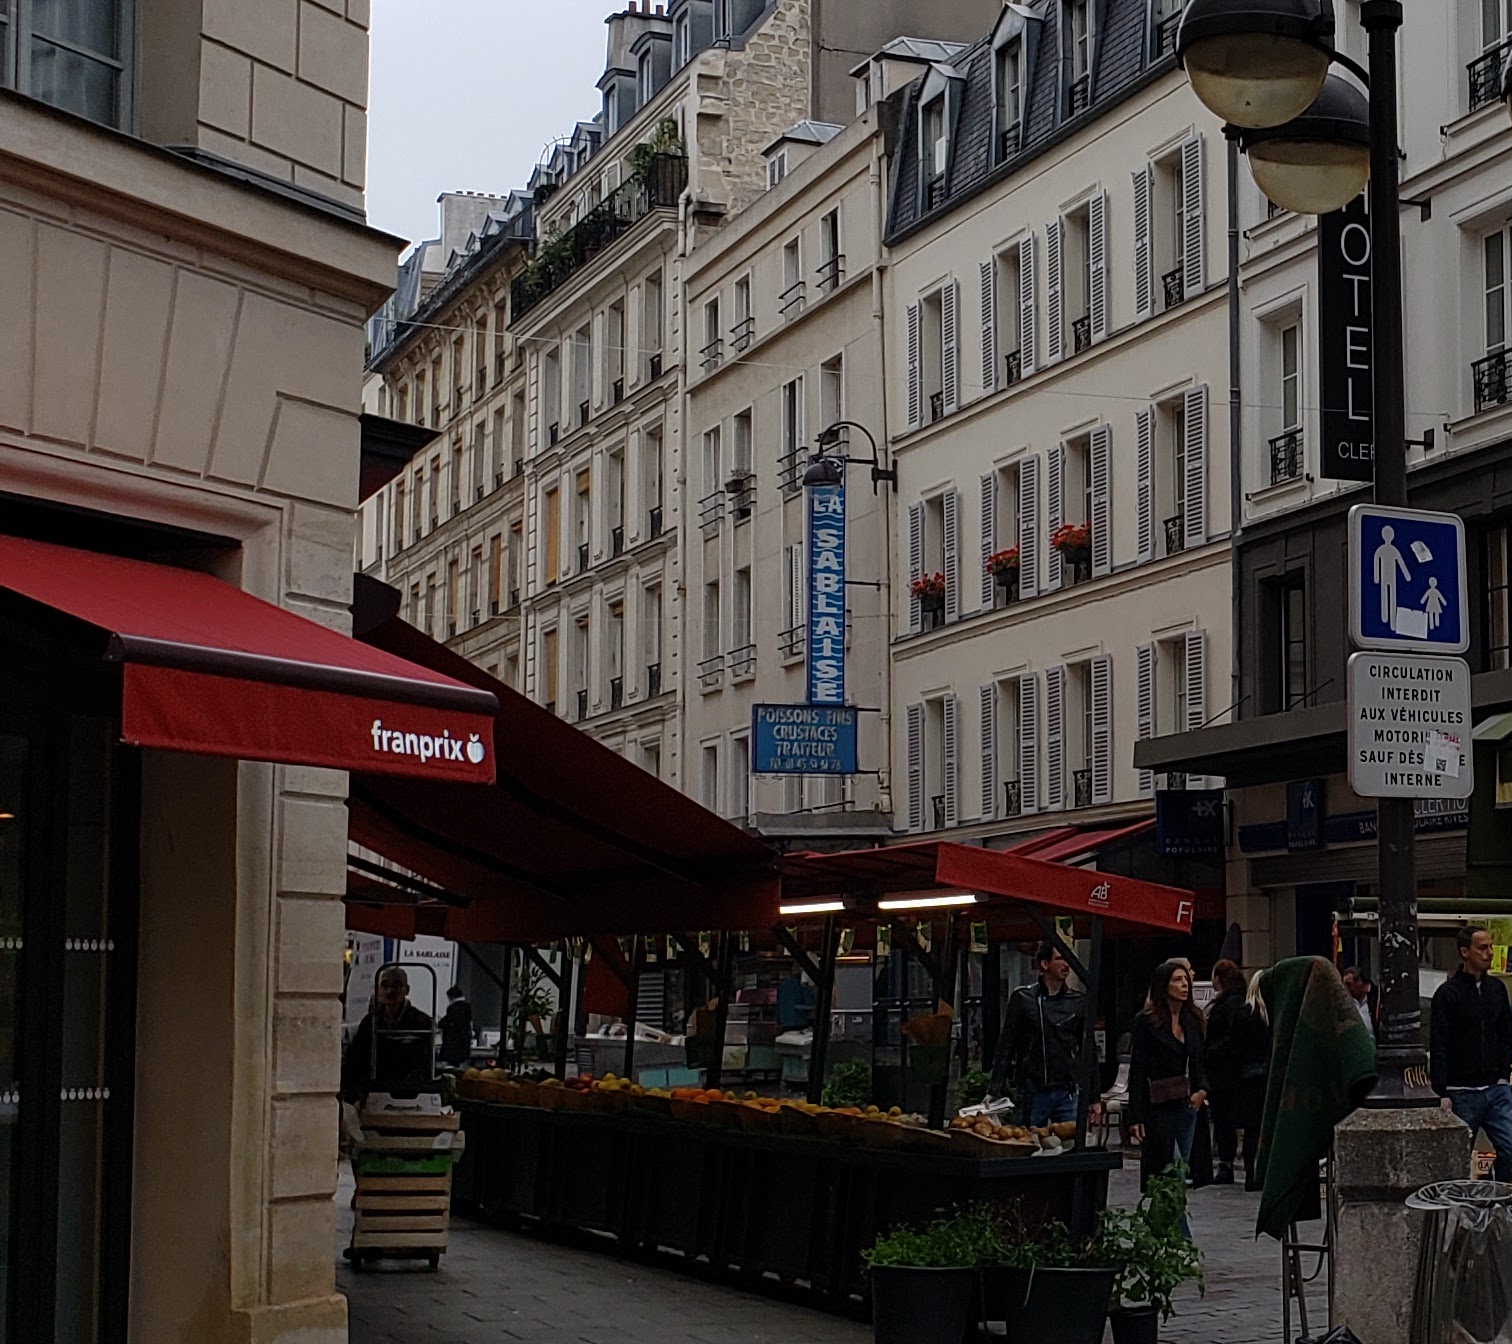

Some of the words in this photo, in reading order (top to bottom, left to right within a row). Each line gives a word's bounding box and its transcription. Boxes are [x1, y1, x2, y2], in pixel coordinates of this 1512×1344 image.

[813, 494, 843, 513] LA
[816, 529, 840, 702] SABLAISE
[1369, 665, 1453, 682] CIRCULATION
[1381, 687, 1441, 702] INTERDIT
[757, 707, 820, 724] POISSONS
[826, 709, 852, 725] FINS
[1360, 707, 1385, 721] AUX
[1391, 706, 1463, 724] VÉHICULES
[371, 719, 465, 763] franprix
[774, 741, 835, 757] TRAITEUR
[1360, 750, 1394, 764] SAUF
[1384, 772, 1442, 787] INTERNE
